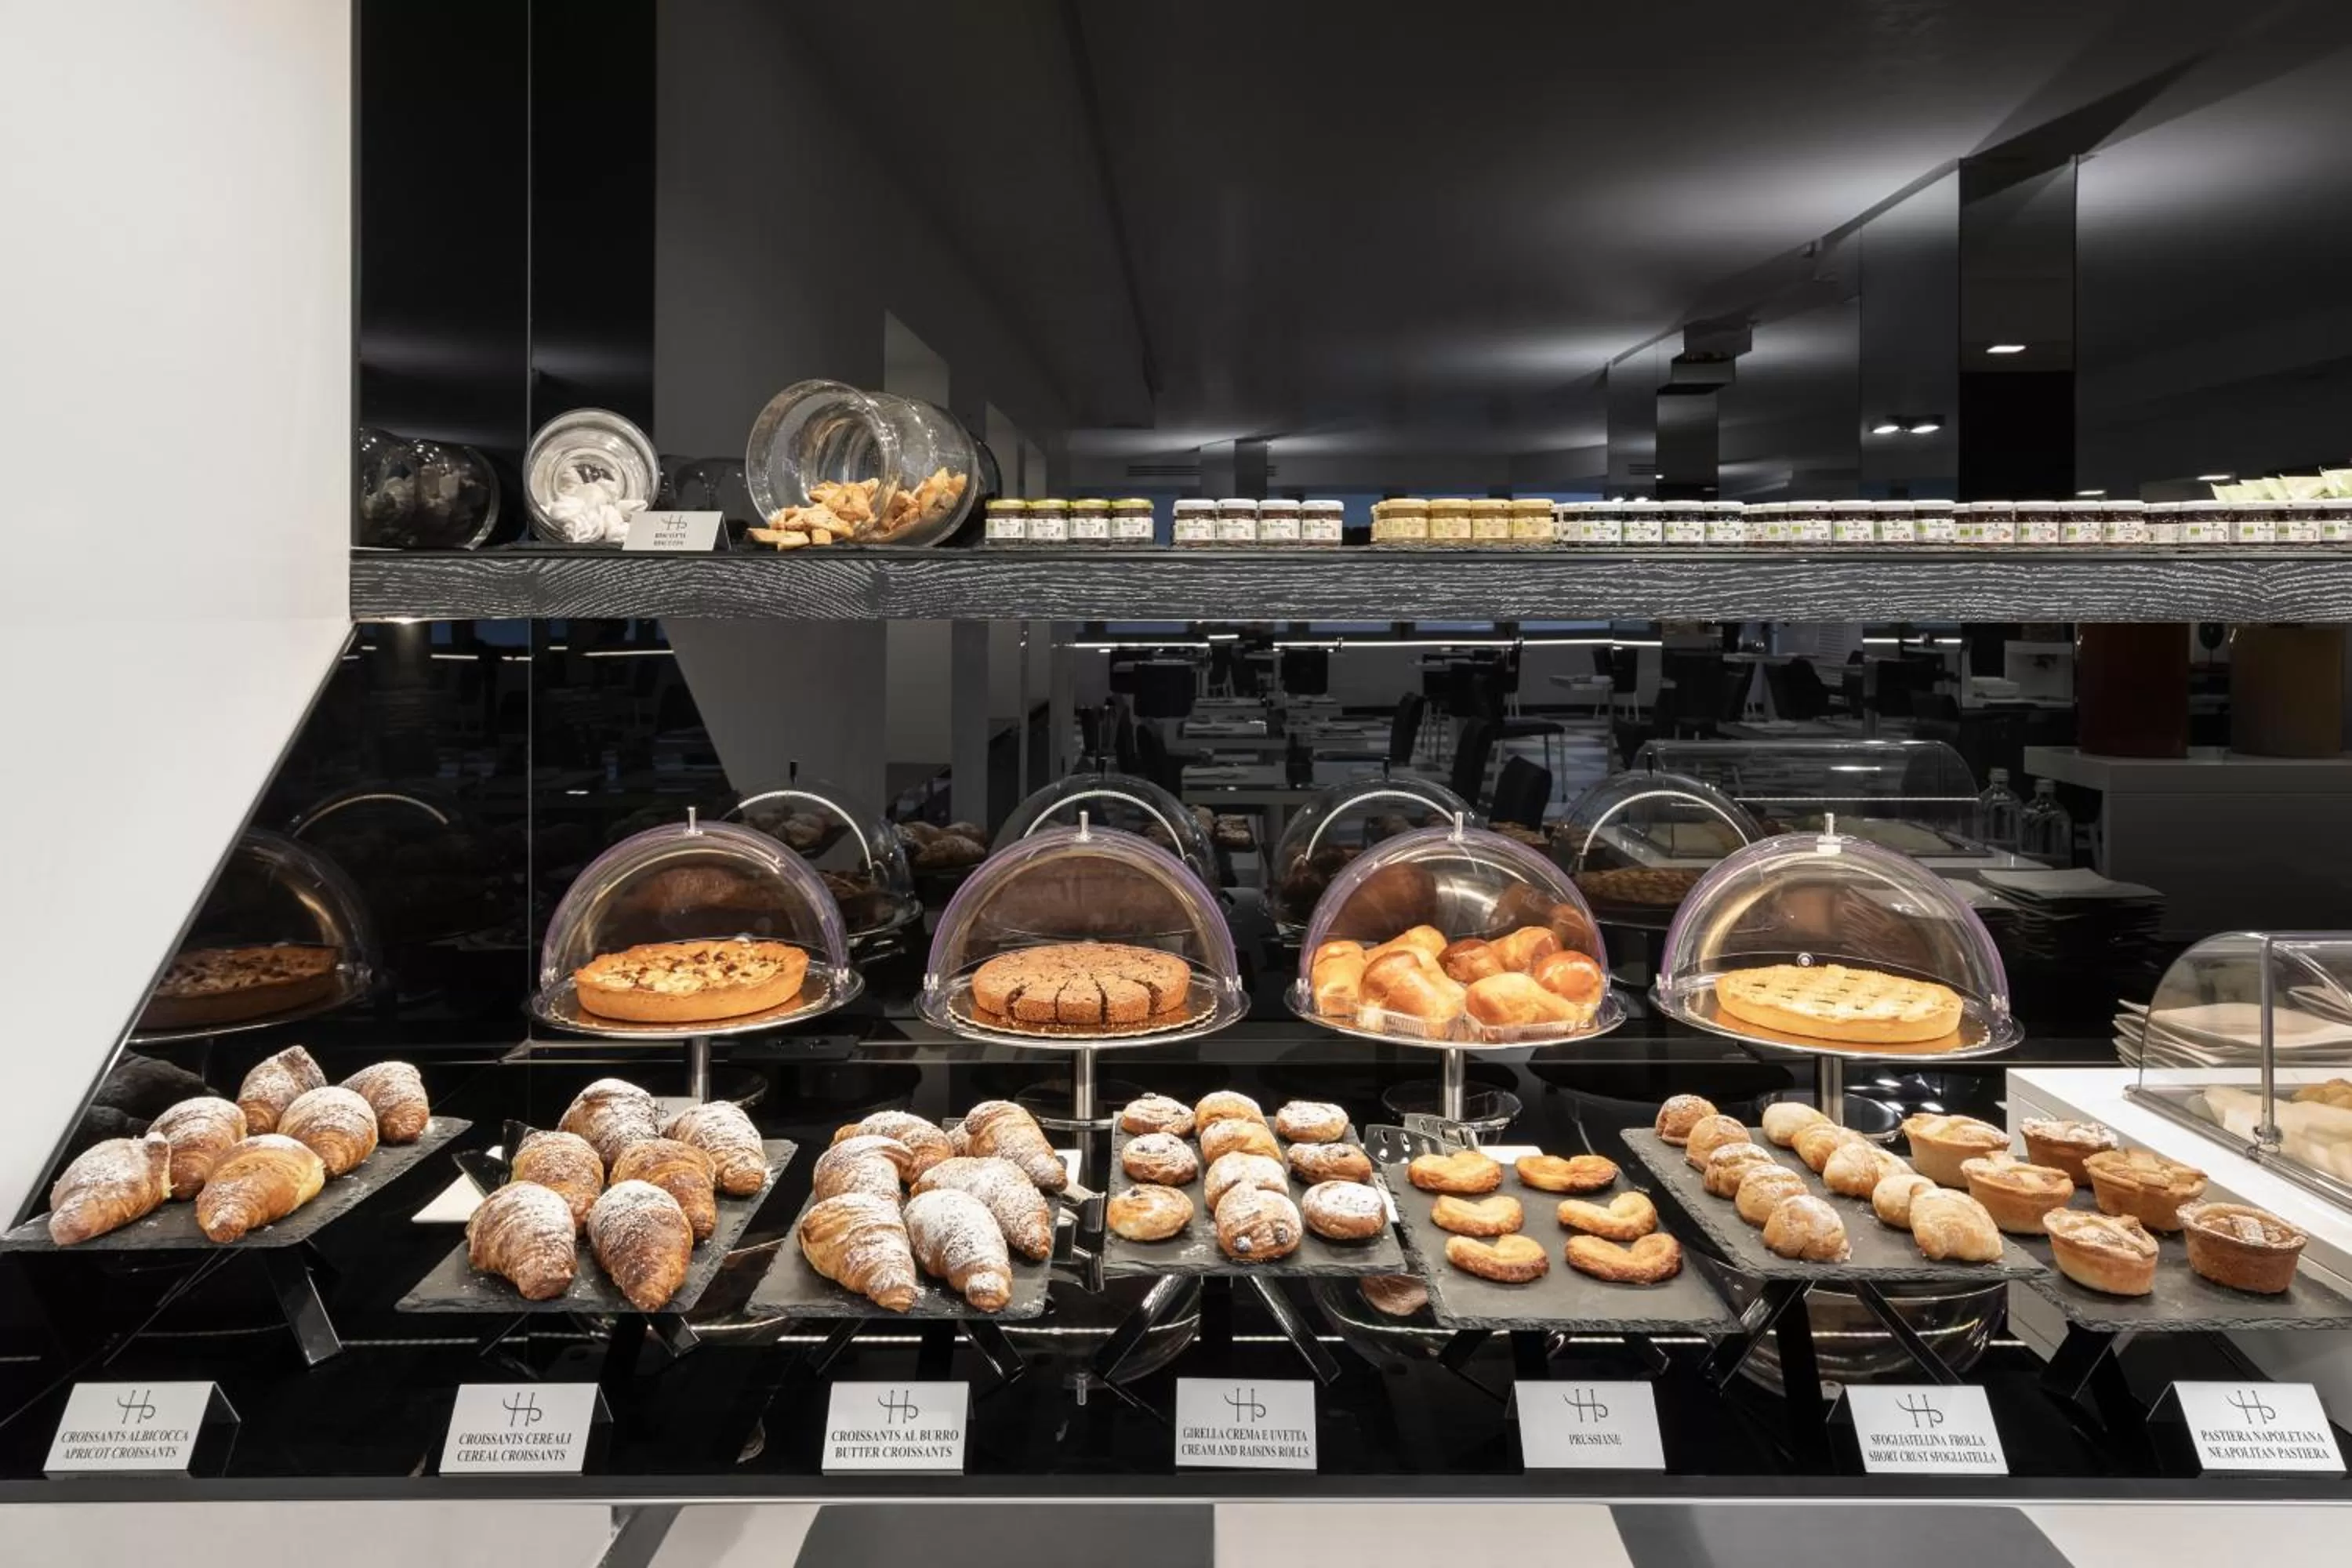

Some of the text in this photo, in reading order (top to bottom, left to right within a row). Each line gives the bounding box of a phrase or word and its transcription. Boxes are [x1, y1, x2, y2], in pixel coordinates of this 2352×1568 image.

[61, 1430, 189, 1443] CROISSANTS ALBICOCCA
[459, 1433, 572, 1445] CROISSANTS CEREALI
[832, 1430, 959, 1442] CROISSANTS AL BURRO
[1183, 1427, 1225, 1439] GIRELLA
[1226, 1428, 1261, 1440] CREMA
[1270, 1430, 1307, 1441] UVETTA
[2201, 1430, 2325, 1443] PASTIERA NAPOLETANA
[64, 1446, 176, 1459] APRICOT CROISSANTS
[457, 1450, 565, 1461] CEREAL CROISSANTS
[835, 1446, 952, 1458] BUTTER CROISSANTS
[1181, 1444, 1309, 1458] CREAM AND RAISINS ROLLS
[2208, 1446, 2330, 1459] NEAPOLITAN PASTIERA
